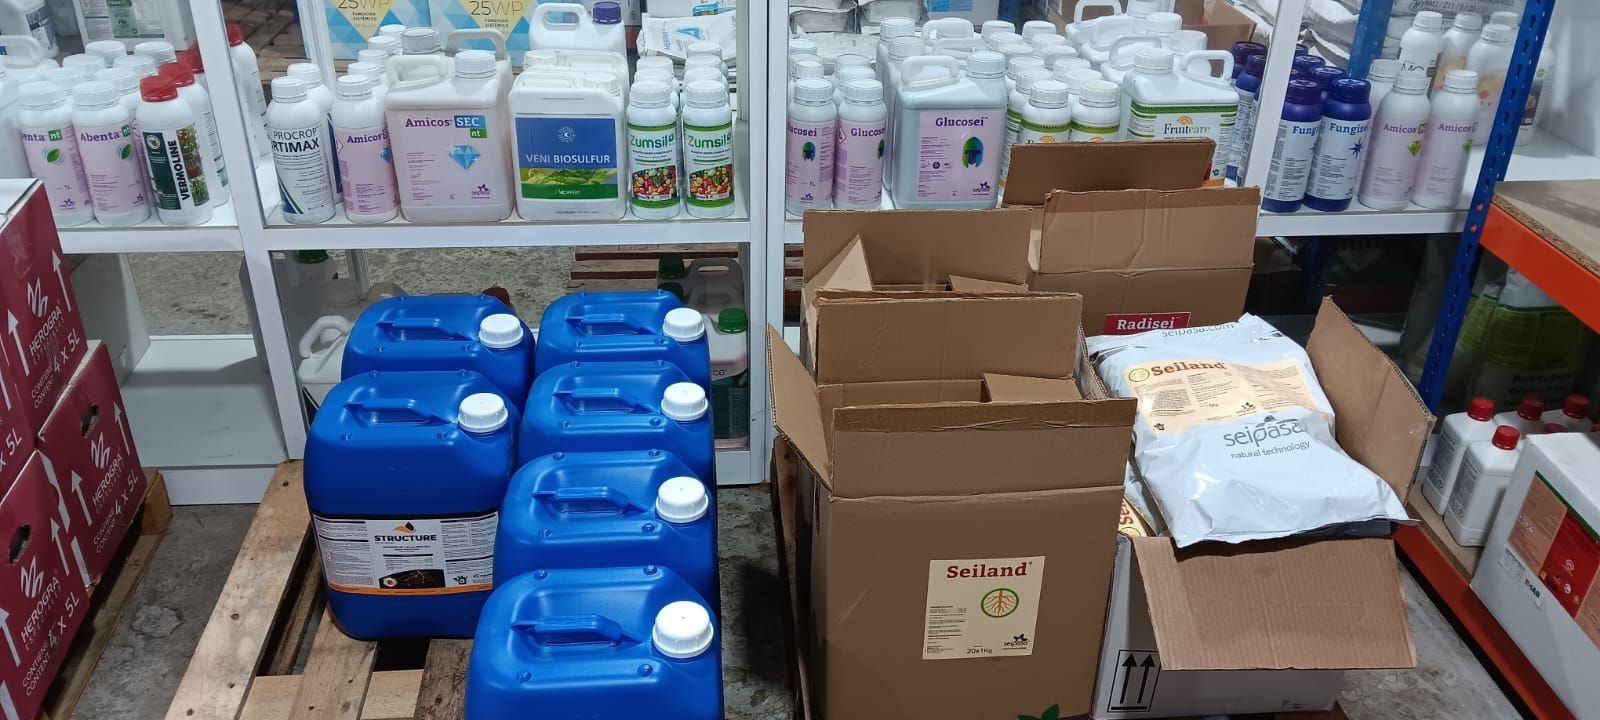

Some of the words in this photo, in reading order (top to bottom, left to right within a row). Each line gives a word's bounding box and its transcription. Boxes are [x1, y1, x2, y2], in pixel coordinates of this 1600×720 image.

[470, 1, 523, 15] 25WP
[405, 117, 450, 128] Amicos
[456, 117, 480, 127] SEC
[935, 116, 985, 127] Glucosei
[1163, 123, 1211, 135] Fruitcare
[1383, 123, 1417, 134] Amicos
[49, 131, 61, 139] nt
[80, 131, 120, 142] Abenta
[122, 126, 131, 135] nt
[273, 128, 317, 141] PROCROP
[630, 134, 667, 149] Zumsil
[688, 134, 726, 149] Zumsil
[525, 154, 551, 163] VENI
[553, 154, 611, 164] BIOSULFUR
[168, 139, 190, 200] VERMOLINE
[29, 305, 62, 356] HEROGRA
[1116, 317, 1175, 330] Radisei
[53, 356, 60, 373] 4
[67, 328, 80, 352] 5L
[5, 427, 22, 456] 5L
[1223, 421, 1305, 448] seipasa
[1230, 449, 1262, 459] natural
[1262, 440, 1311, 456] technology
[92, 453, 123, 507] HEROGRA
[115, 499, 121, 516] 4
[127, 470, 139, 493] 5L
[374, 534, 438, 542] STRUCTURE
[946, 561, 1028, 579] Seiland
[20, 576, 60, 643] HEROGRA
[48, 629, 58, 648] 4
[64, 591, 80, 618] 5L
